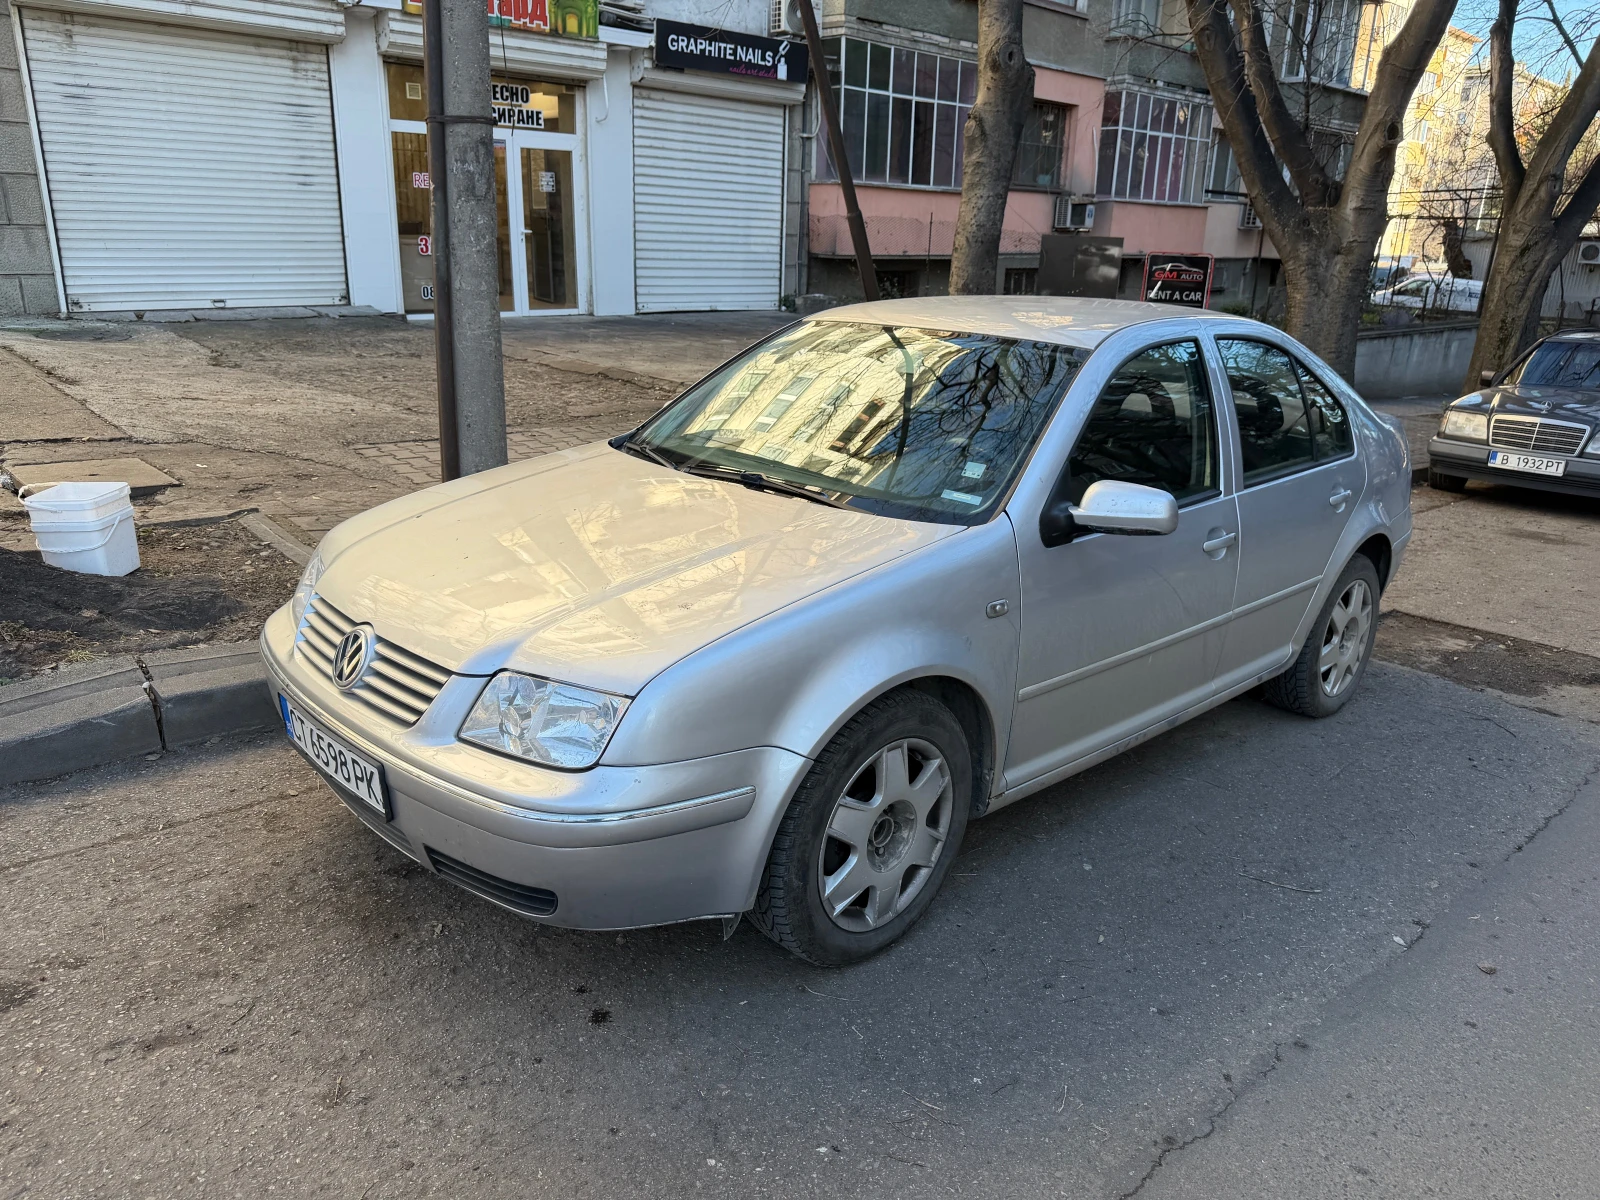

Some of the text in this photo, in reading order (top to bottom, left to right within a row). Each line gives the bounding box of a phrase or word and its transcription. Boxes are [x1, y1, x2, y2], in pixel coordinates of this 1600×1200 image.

[667, 34, 774, 67] GRAPHITE NAILS
[1154, 271, 1177, 279] GM
[1173, 291, 1180, 300] A
[1182, 291, 1202, 301] CAR
